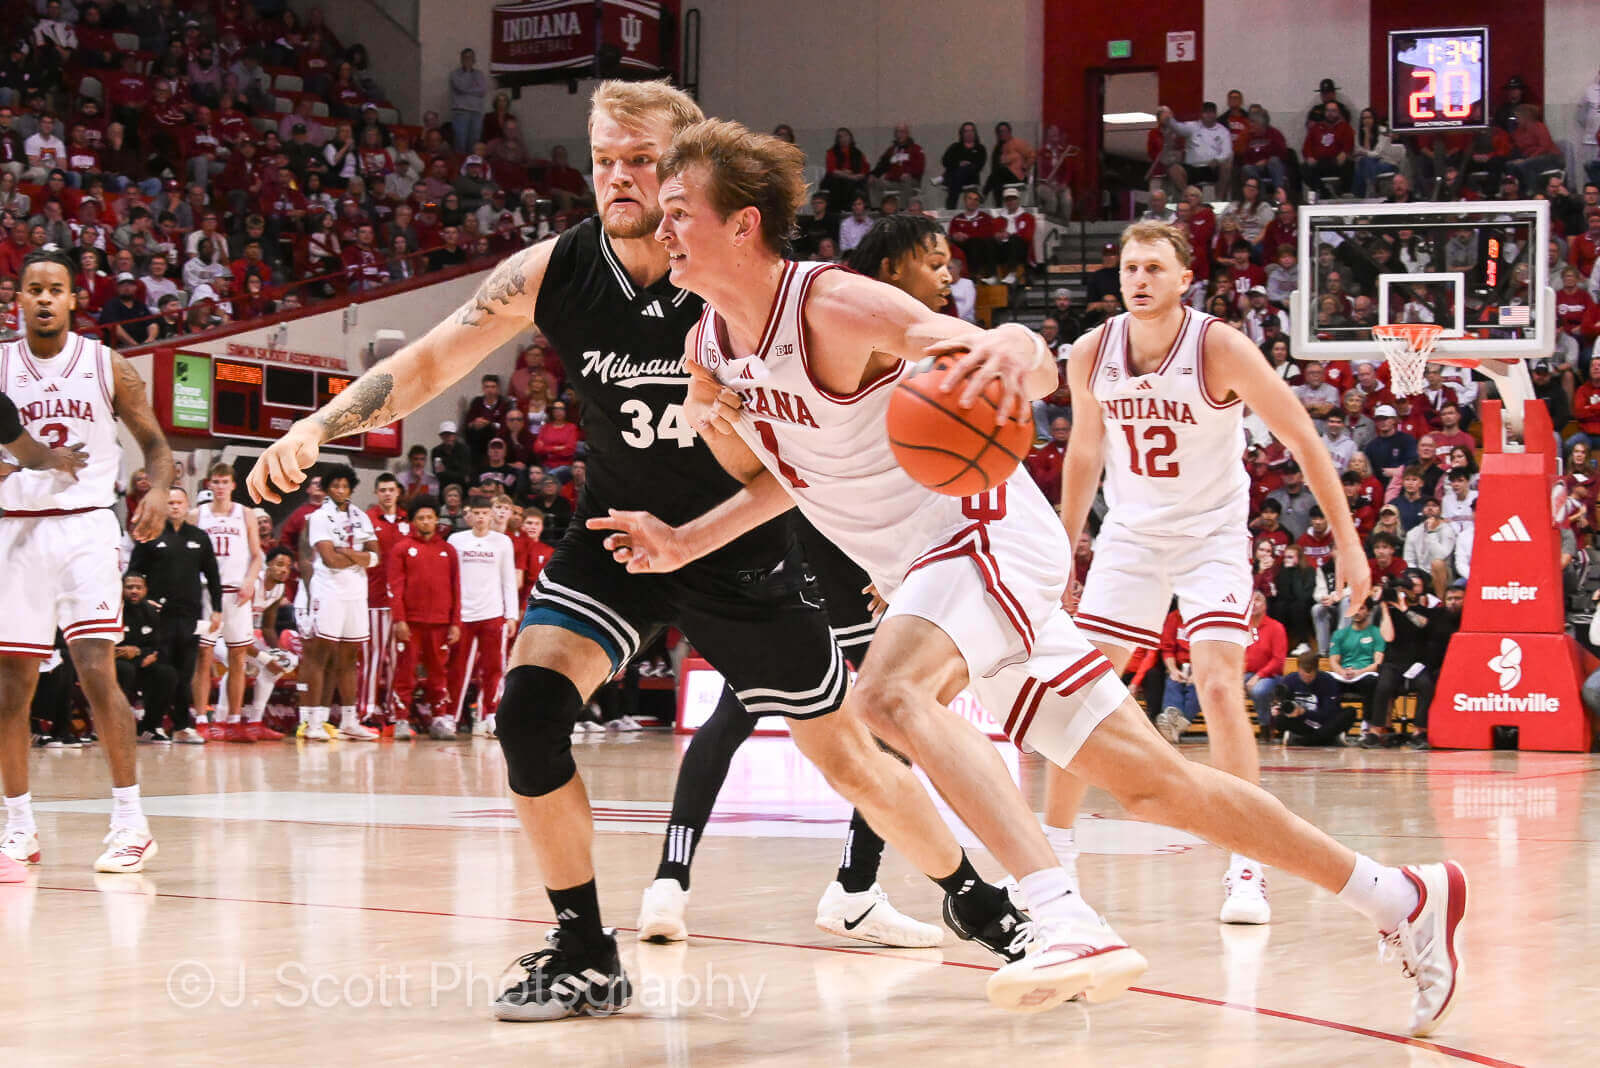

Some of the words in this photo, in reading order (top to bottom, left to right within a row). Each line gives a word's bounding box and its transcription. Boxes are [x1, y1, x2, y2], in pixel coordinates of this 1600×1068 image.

[503, 12, 581, 43] INDIANA
[1175, 43, 1184, 58] 5
[1427, 40, 1480, 65] 1:34
[1409, 70, 1471, 119] 20
[581, 350, 690, 384] Milwauk
[19, 398, 95, 426] NDIANA
[620, 399, 698, 449] 34
[1101, 397, 1198, 425] NDIANA
[753, 420, 811, 489] 1
[1121, 425, 1179, 478] 12
[214, 536, 230, 557] 11
[1481, 581, 1538, 604] meijer
[1453, 693, 1560, 712] Smithville
